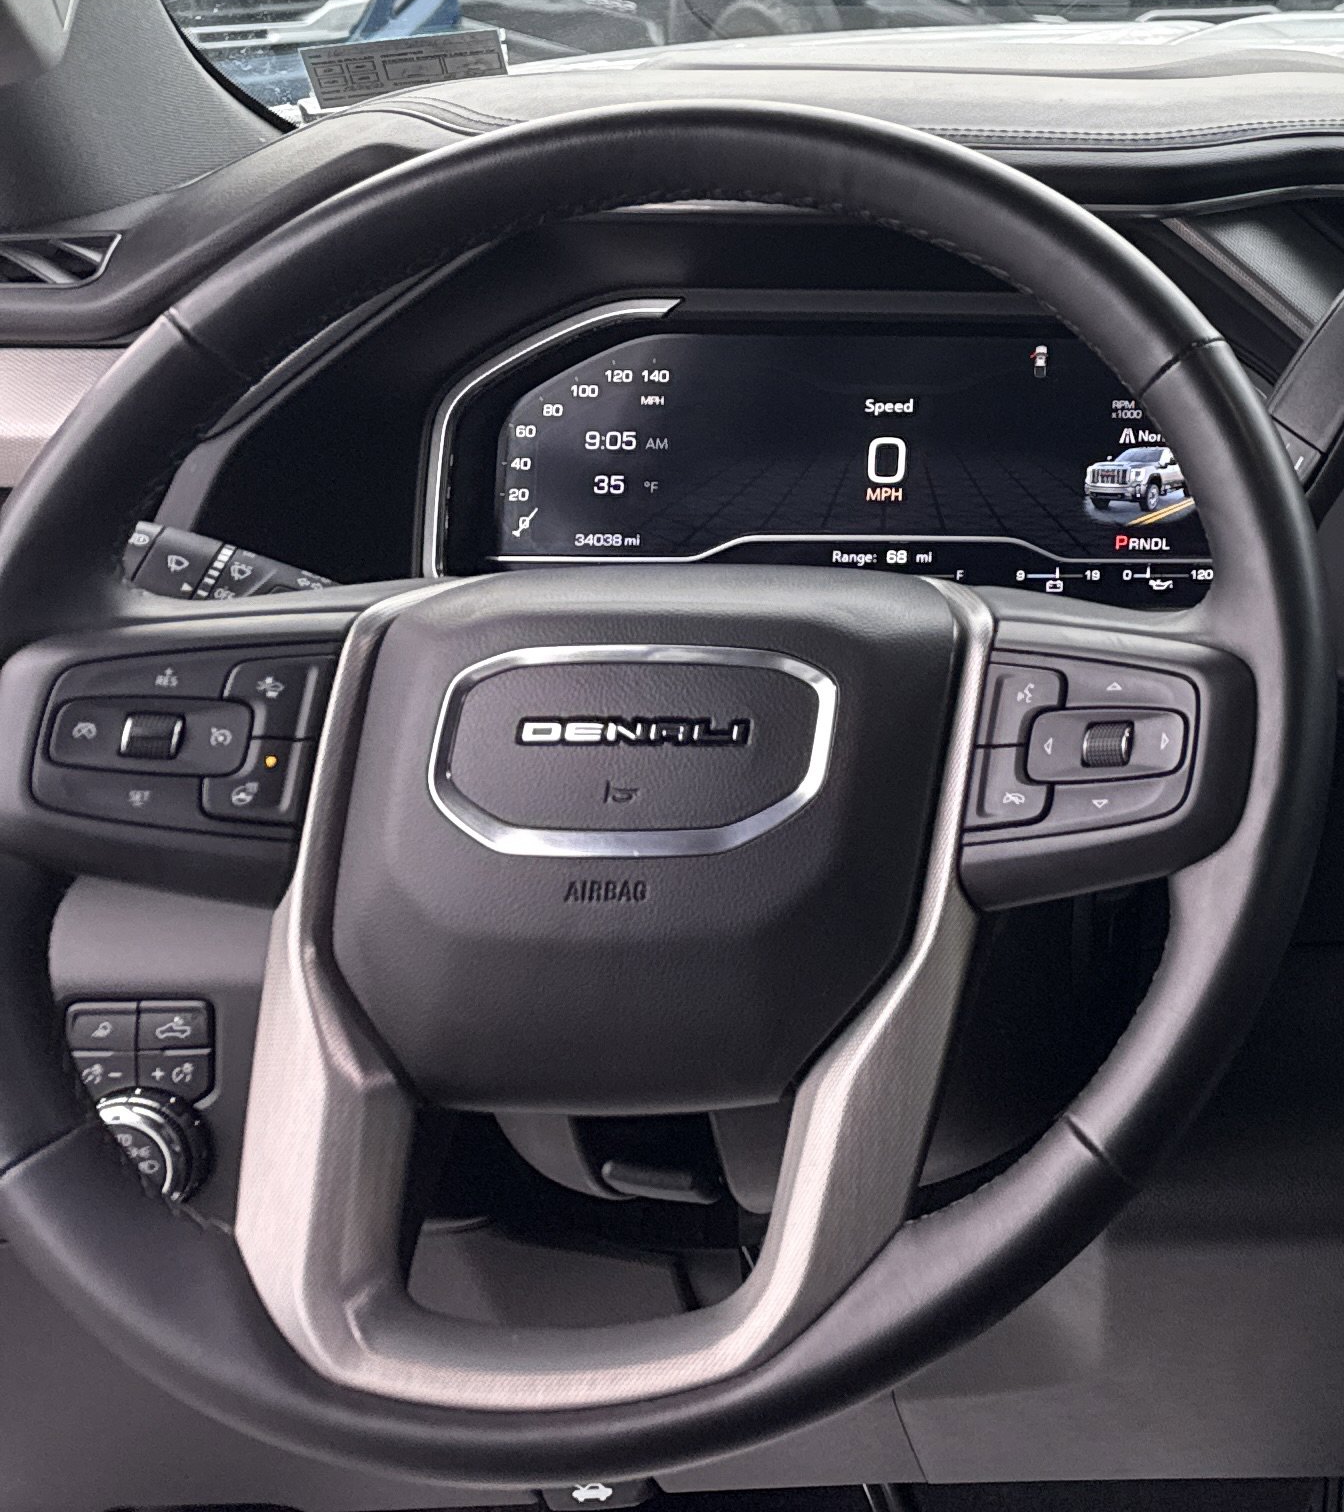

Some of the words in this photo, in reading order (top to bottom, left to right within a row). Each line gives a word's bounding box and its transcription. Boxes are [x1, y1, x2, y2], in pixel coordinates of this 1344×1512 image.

[605, 369, 633, 383] 120
[641, 369, 670, 383] 140
[570, 384, 599, 398] 100
[640, 395, 665, 406] MPH
[864, 398, 914, 416] Speed
[1111, 399, 1136, 410] RPM
[542, 403, 564, 417] 80
[1111, 409, 1142, 419] x1000
[515, 424, 537, 438] 60
[1137, 429, 1165, 443] Nor
[585, 431, 637, 450] 9:05
[645, 437, 669, 450] AM
[510, 457, 532, 471] 40
[867, 436, 907, 484] 0
[593, 474, 625, 494] 35
[508, 488, 530, 502] 20
[866, 487, 903, 501] MPH
[574, 533, 622, 547] 34038
[624, 533, 641, 547] mi
[832, 550, 878, 567] Range:
[886, 549, 908, 564] 68
[915, 550, 933, 563] mi
[956, 569, 965, 581] F
[1122, 569, 1133, 581] 0
[1190, 569, 1214, 581] 120
[519, 719, 751, 744] DENALI
[562, 879, 648, 904] AIRBAG
